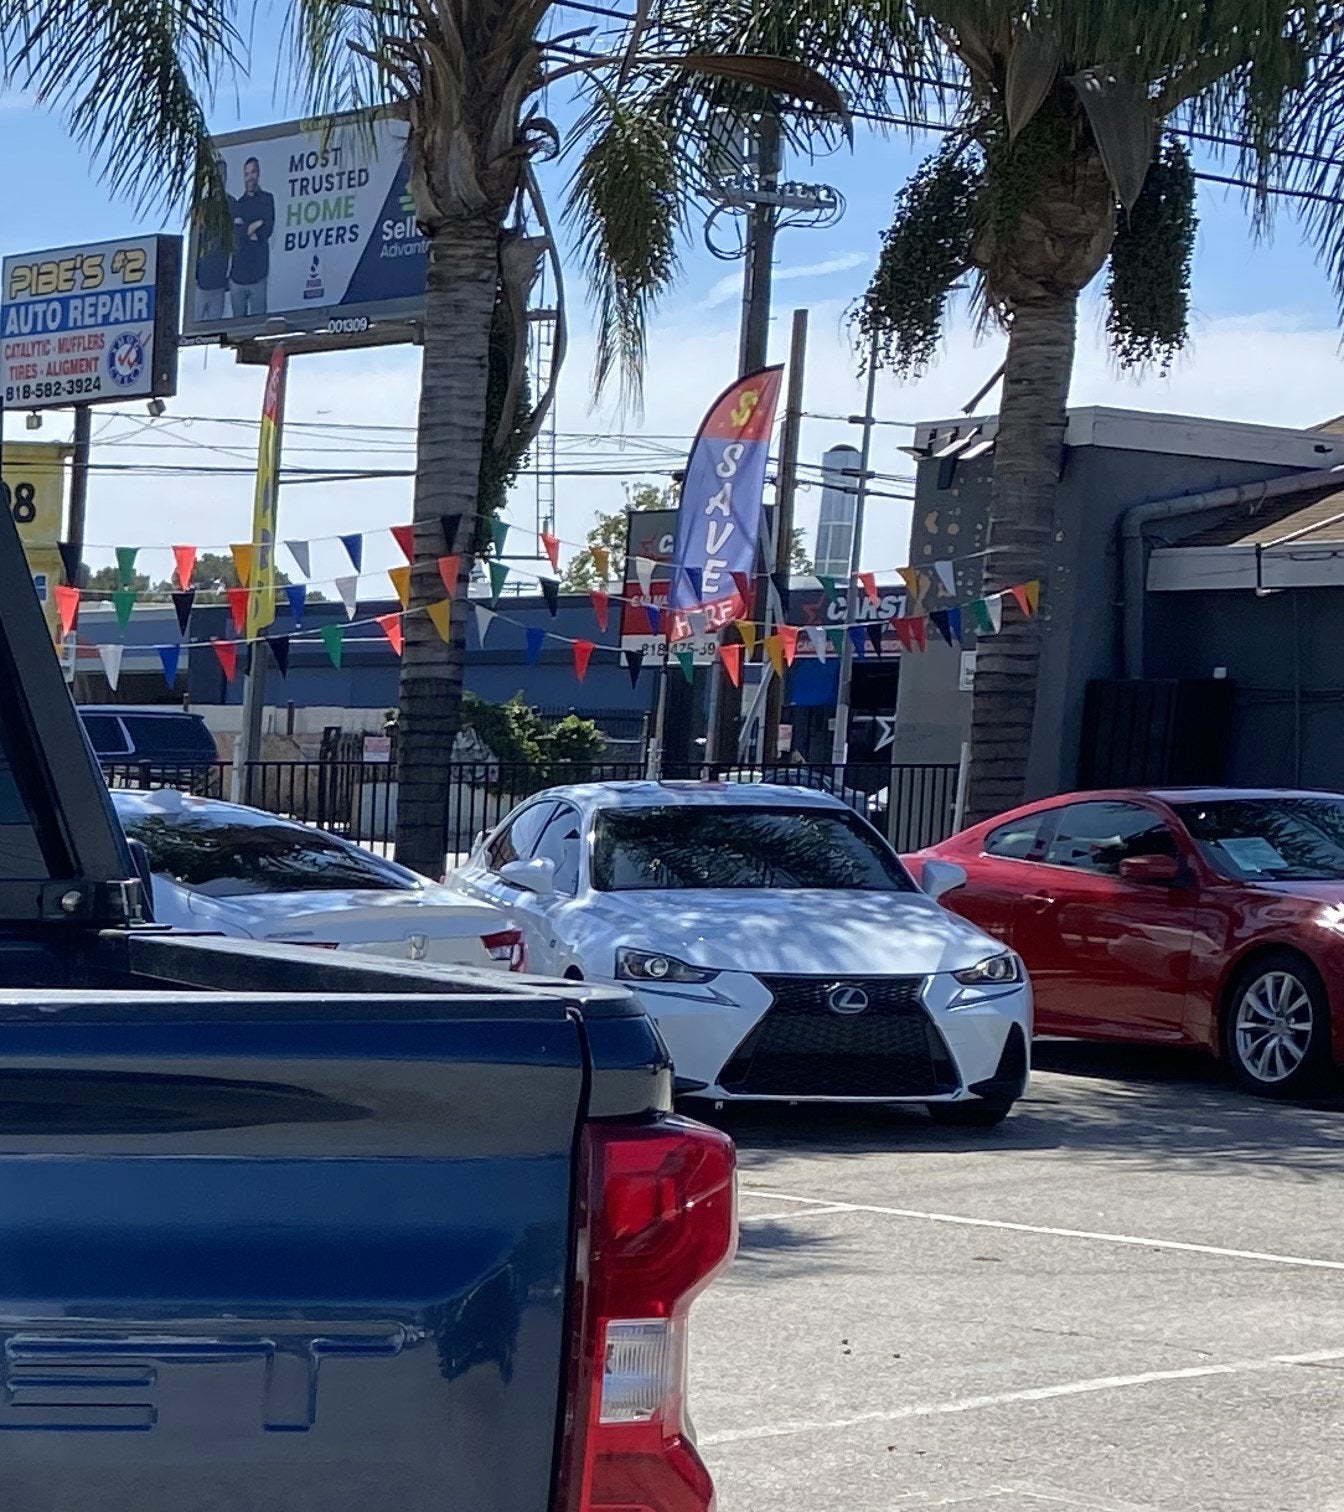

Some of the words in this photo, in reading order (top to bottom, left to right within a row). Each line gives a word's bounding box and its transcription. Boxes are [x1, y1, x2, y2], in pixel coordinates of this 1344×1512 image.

[288, 147, 342, 174] MOST
[288, 167, 370, 198] TRUSTED
[285, 195, 355, 228] HOME
[284, 223, 360, 252] BUYERS
[382, 215, 424, 241] Sell
[10, 253, 106, 300] PIBE'S
[111, 248, 147, 285] #2
[4, 300, 63, 337] AUTO
[67, 289, 149, 328] REPAIR
[327, 316, 368, 334] 001309
[4, 338, 52, 361] CATALYTIC
[57, 332, 106, 354] MUFFLERS
[9, 364, 38, 381] TIRES
[45, 355, 100, 378] ALIGMENT
[5, 376, 102, 402] 818-582-3924
[703, 442, 745, 594] SAVE
